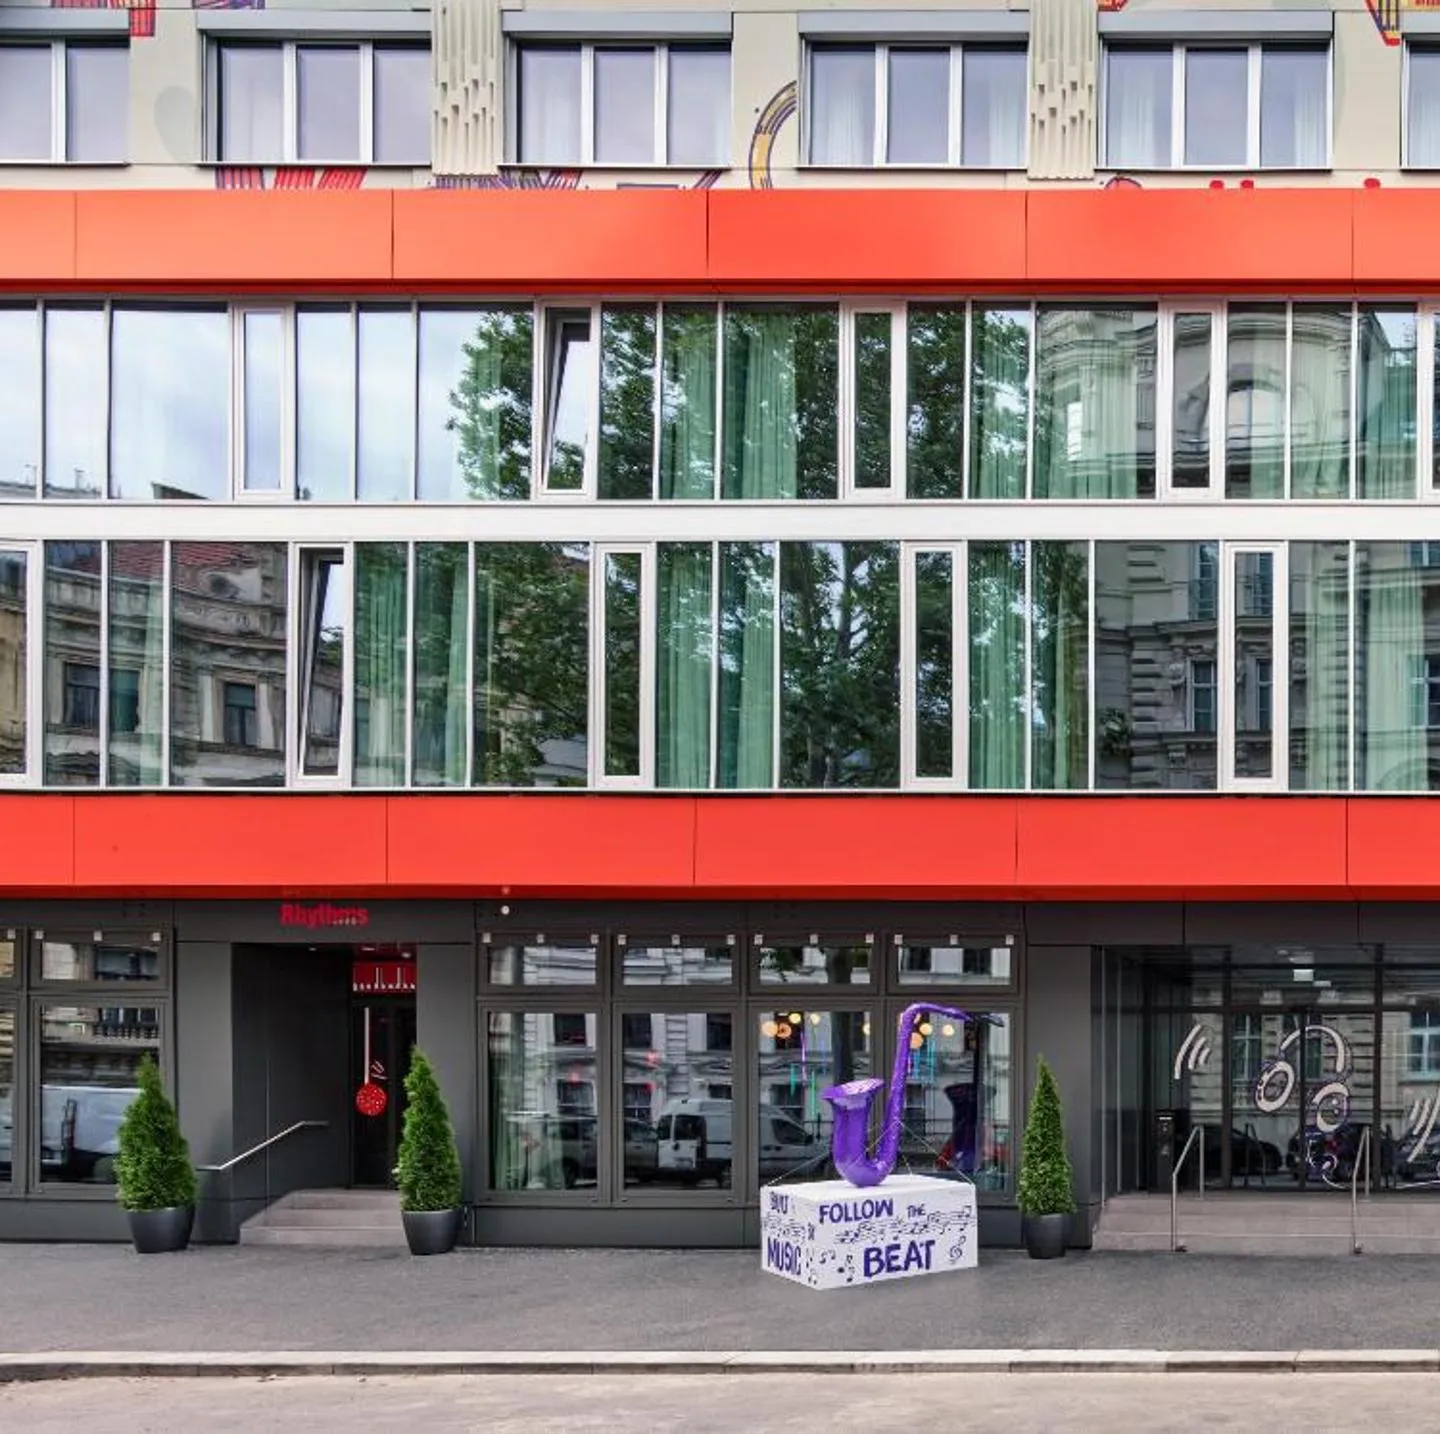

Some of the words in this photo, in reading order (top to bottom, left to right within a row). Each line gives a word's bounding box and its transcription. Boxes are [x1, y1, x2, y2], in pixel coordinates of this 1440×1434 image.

[279, 903, 369, 928] Rhythms
[819, 1198, 894, 1224] FOLLOW
[907, 1203, 926, 1219] THE
[767, 1236, 802, 1276] MUSIC
[863, 1239, 936, 1278] BEAT
